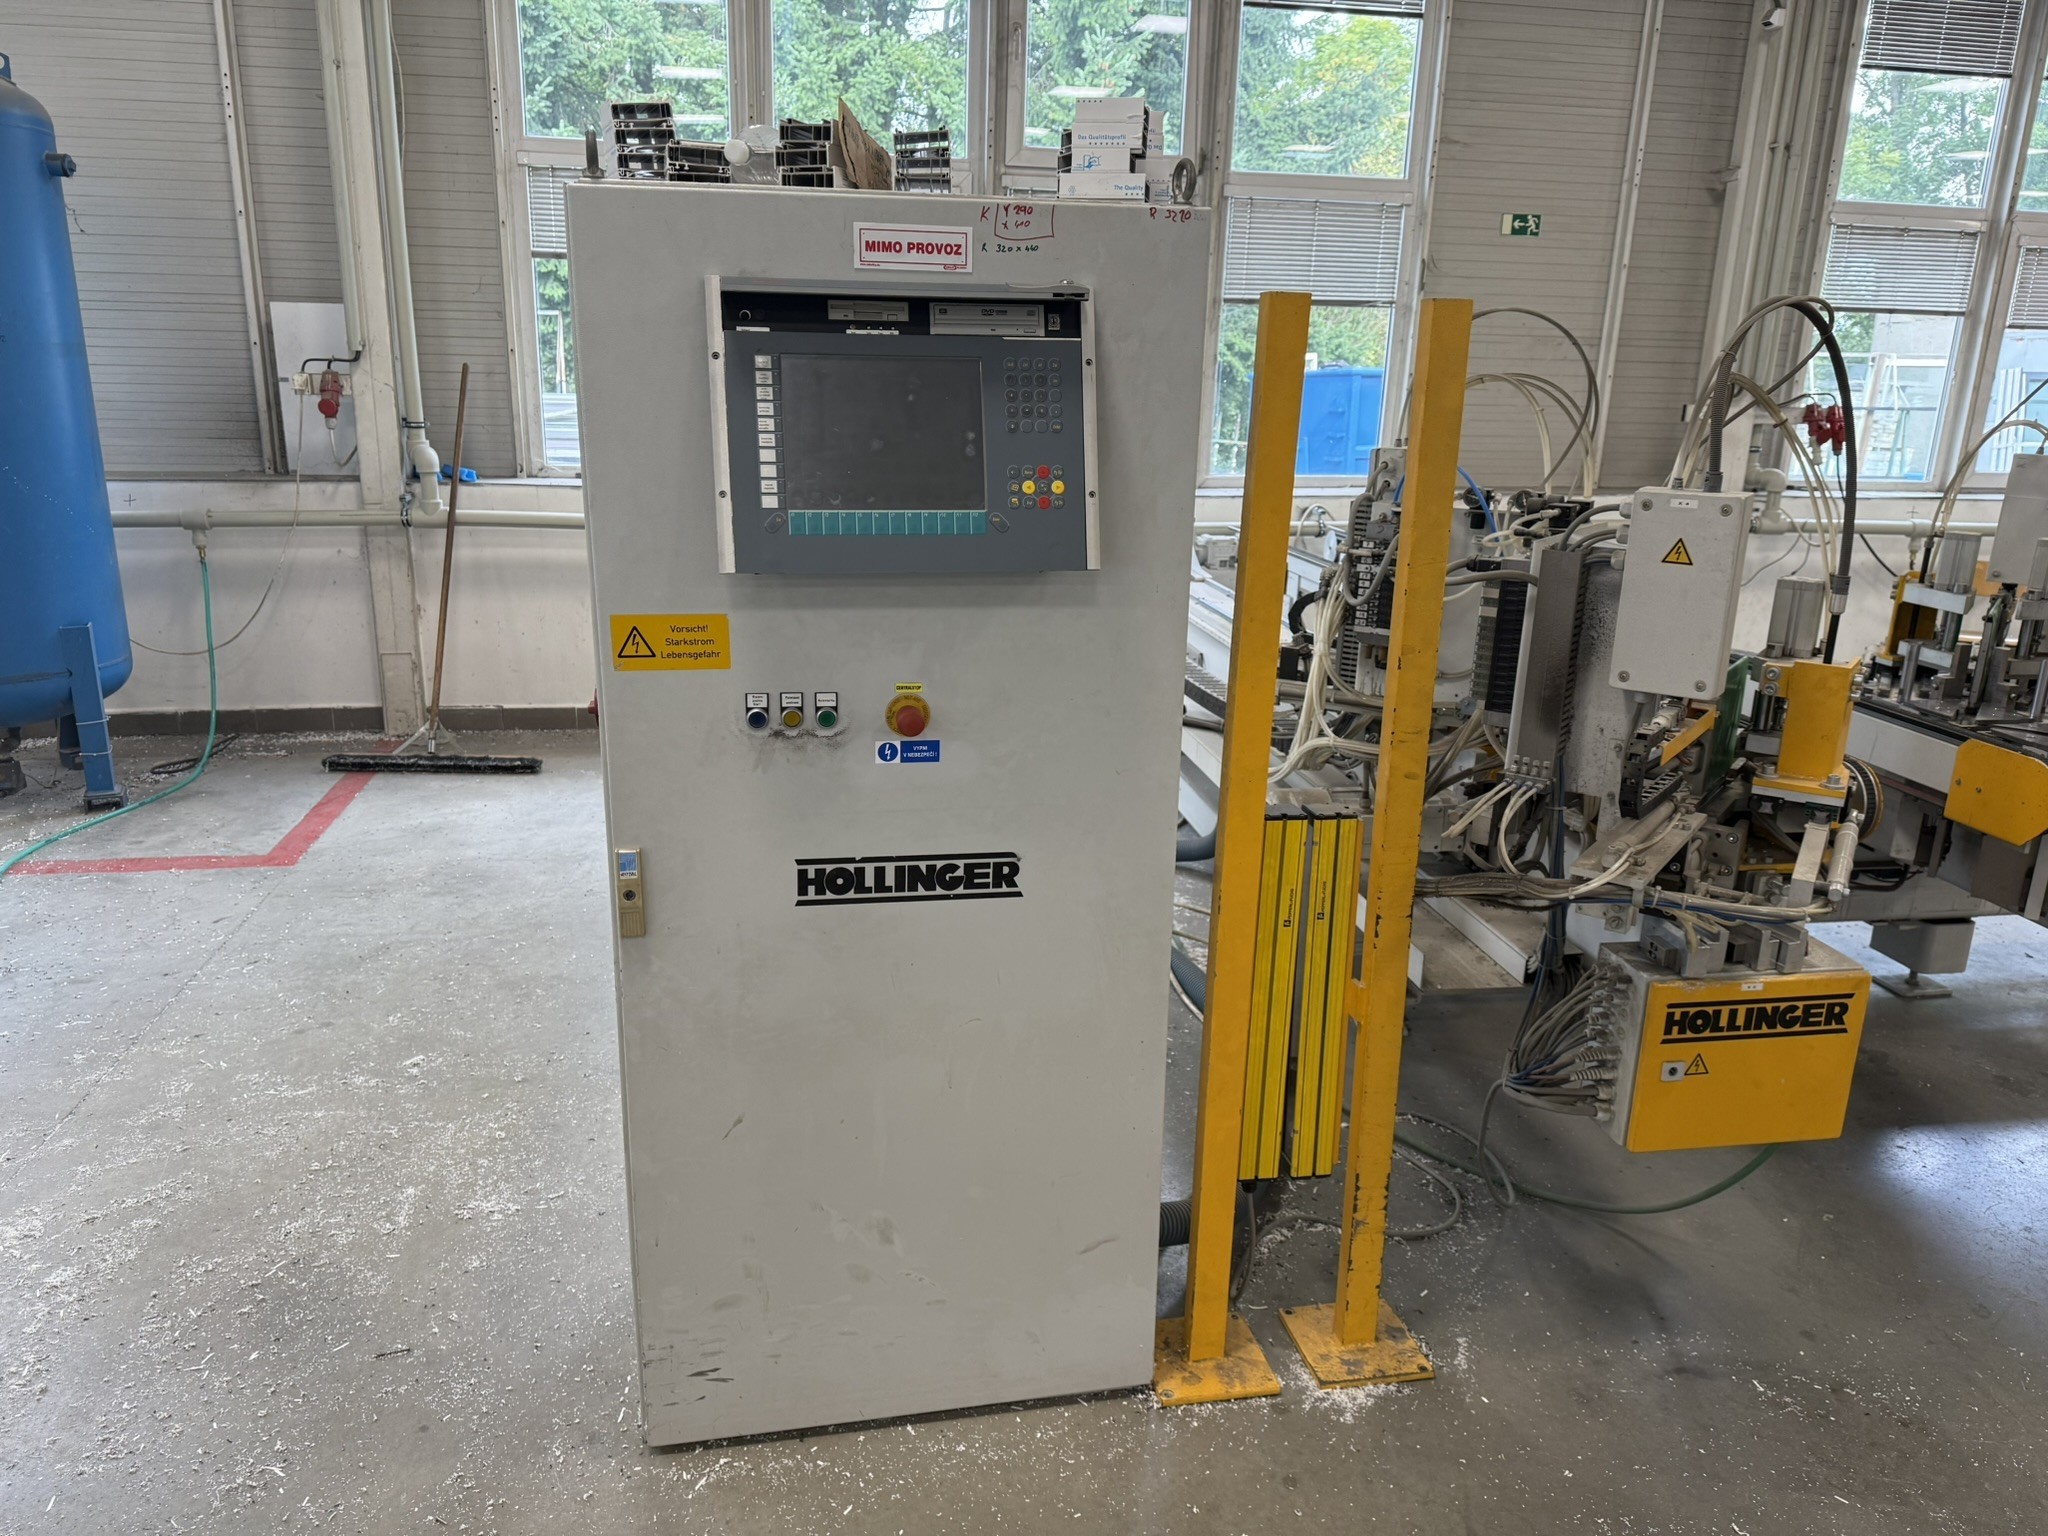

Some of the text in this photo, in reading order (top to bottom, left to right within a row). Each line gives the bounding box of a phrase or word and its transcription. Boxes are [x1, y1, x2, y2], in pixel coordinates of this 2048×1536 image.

[1124, 184, 1144, 192] Quality
[864, 240, 963, 256] MIMO PROVOZ
[995, 243, 1013, 253] 320
[669, 624, 709, 633] Vorsicht!
[665, 637, 715, 646] Starkstrom
[660, 650, 721, 660] Lebensgefahr
[797, 861, 1021, 897] HOLLINGER
[1663, 1001, 1849, 1036] HOLLINGER
